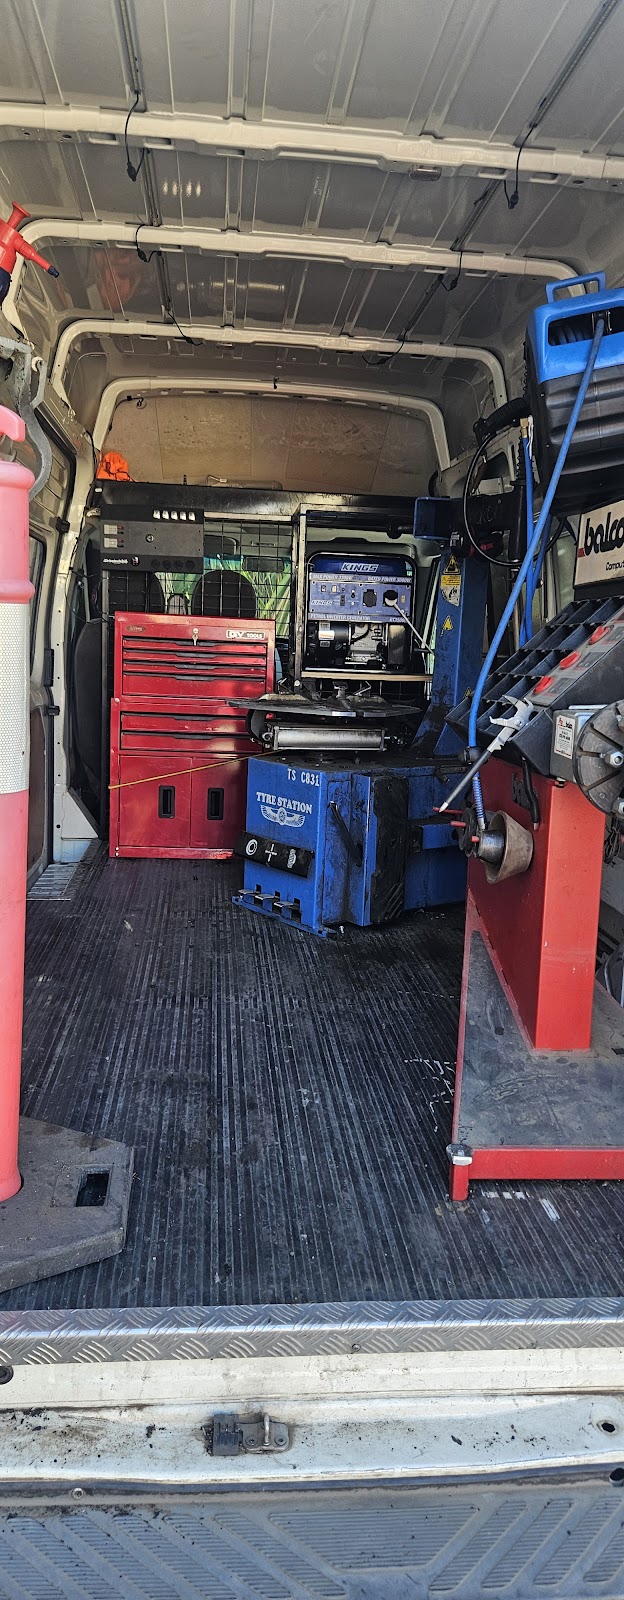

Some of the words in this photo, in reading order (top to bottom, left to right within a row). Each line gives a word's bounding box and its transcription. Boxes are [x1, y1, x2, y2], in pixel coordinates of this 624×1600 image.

[584, 512, 624, 556] balco
[341, 562, 379, 573] KINGS
[287, 768, 296, 781] TS
[300, 771, 319, 787] C831
[256, 791, 276, 805] TYRE
[277, 796, 312, 814] STATION
